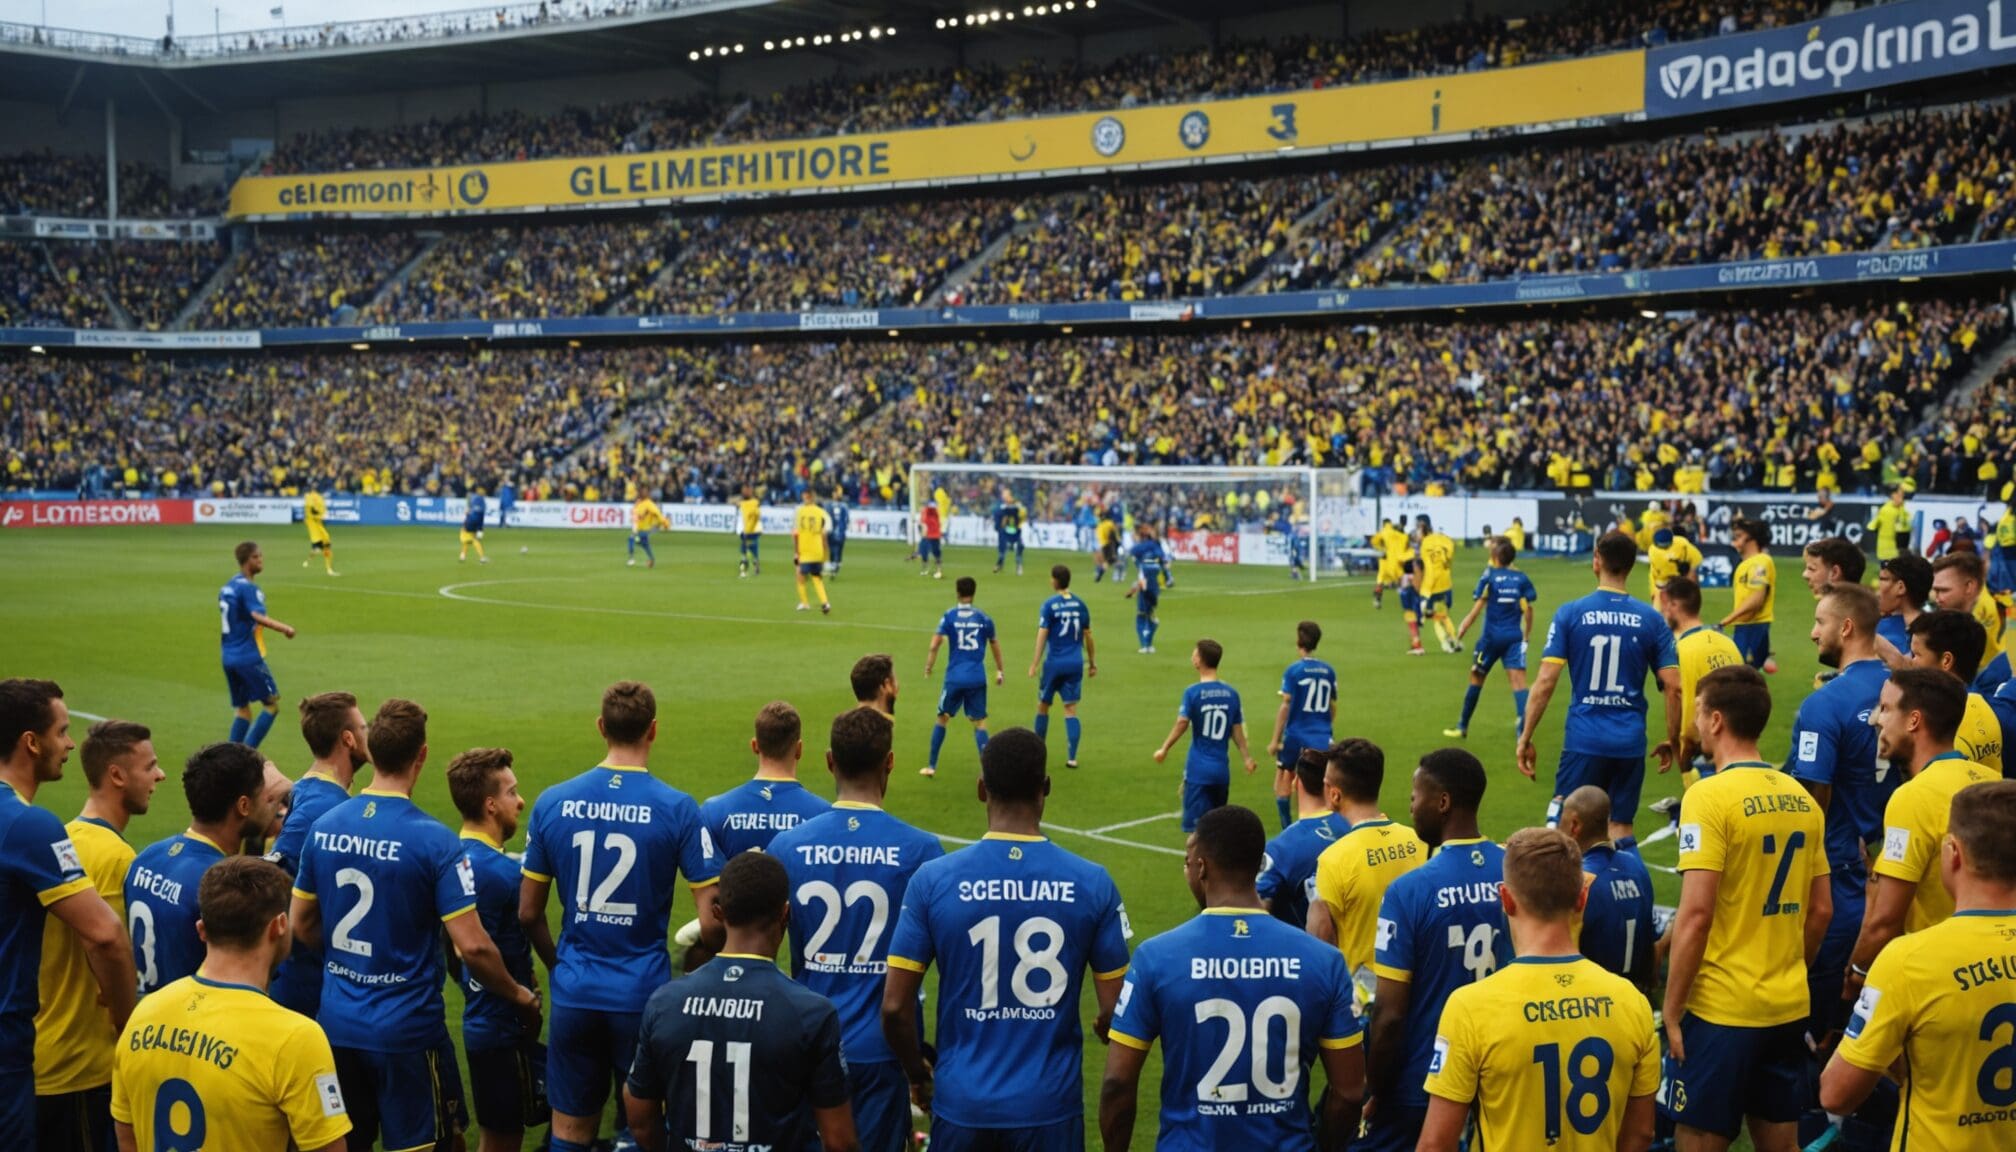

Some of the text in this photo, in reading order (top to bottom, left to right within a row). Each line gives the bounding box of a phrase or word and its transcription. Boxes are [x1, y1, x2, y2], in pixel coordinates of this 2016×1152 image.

[331, 867, 374, 957] 2
[572, 830, 637, 915] 12
[796, 880, 889, 966] 22
[968, 915, 1068, 1010] 18
[686, 1040, 752, 1142] 11
[1195, 995, 1300, 1102] 20
[1533, 1036, 1614, 1145] 18
